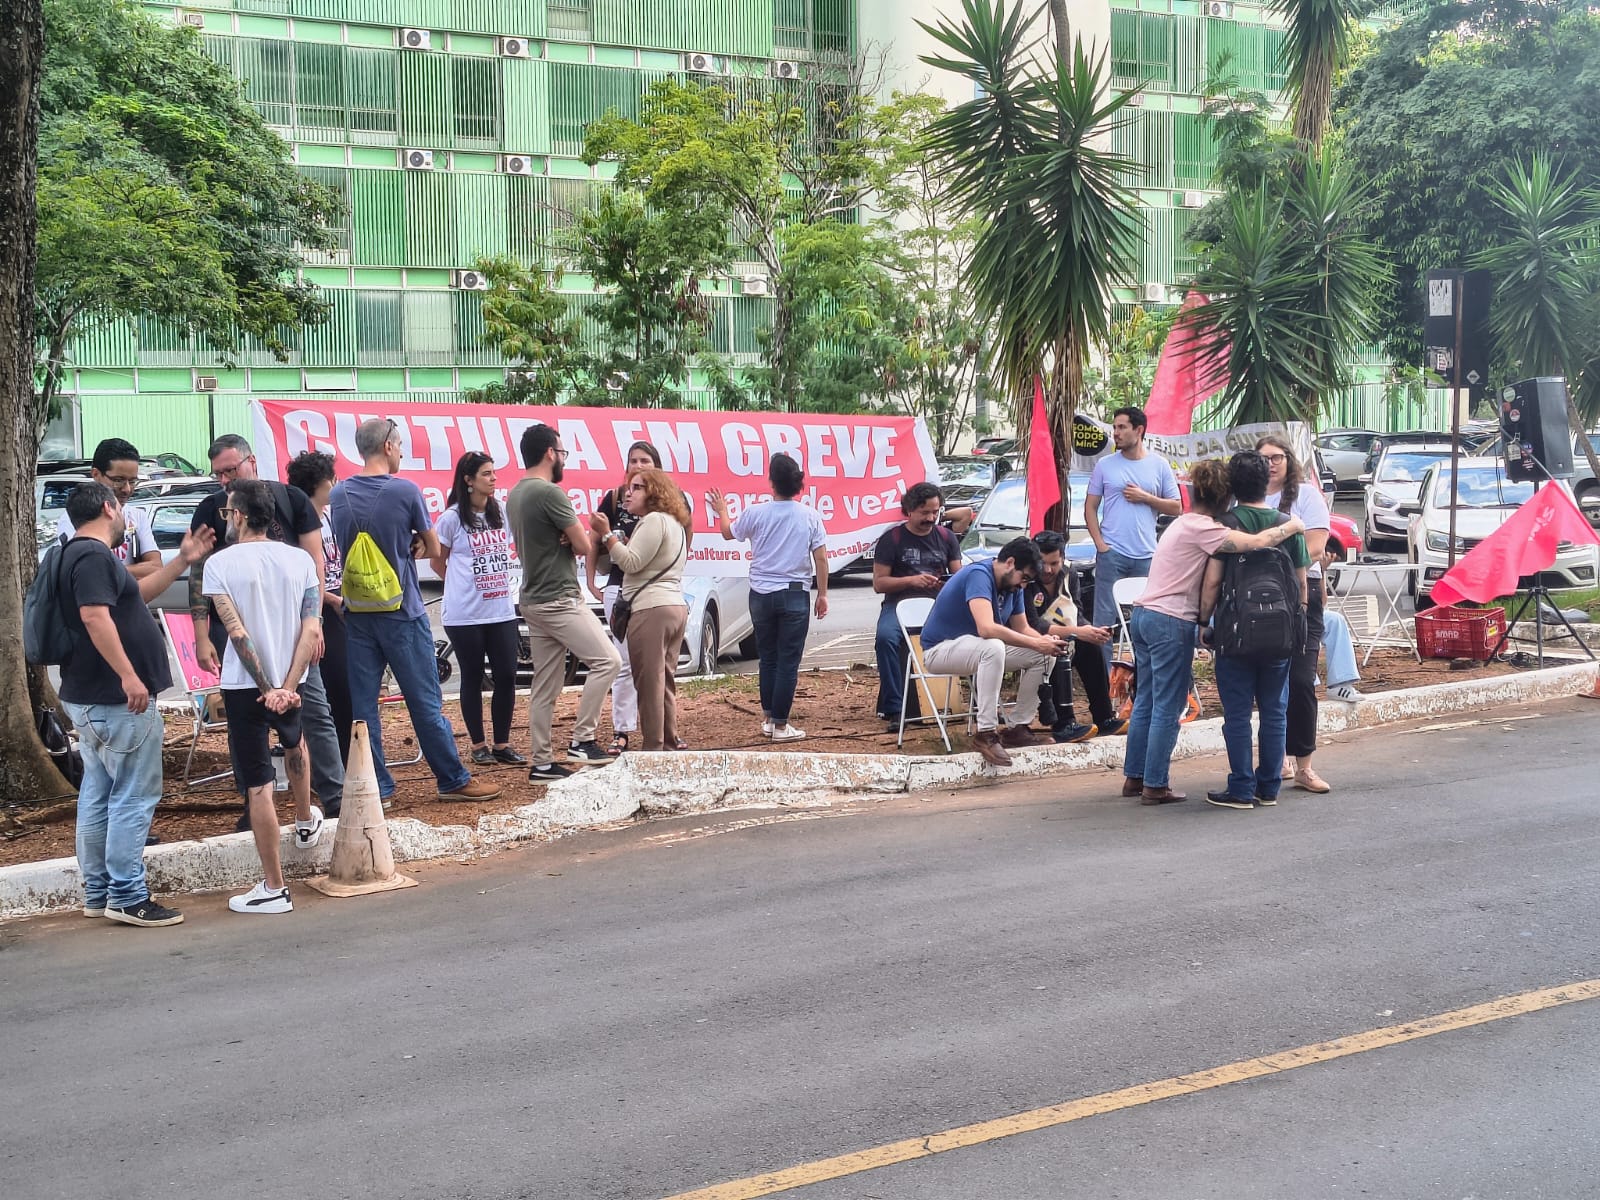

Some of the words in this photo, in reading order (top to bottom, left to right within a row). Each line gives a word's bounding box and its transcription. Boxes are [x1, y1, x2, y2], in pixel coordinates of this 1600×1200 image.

[1072, 424, 1104, 433] SOMOS
[1073, 431, 1104, 441] TODOS
[720, 421, 902, 479] GREVE
[800, 486, 834, 521] de
[687, 547, 740, 561] Cultura
[473, 557, 486, 566] 20
[473, 565, 488, 574] DE
